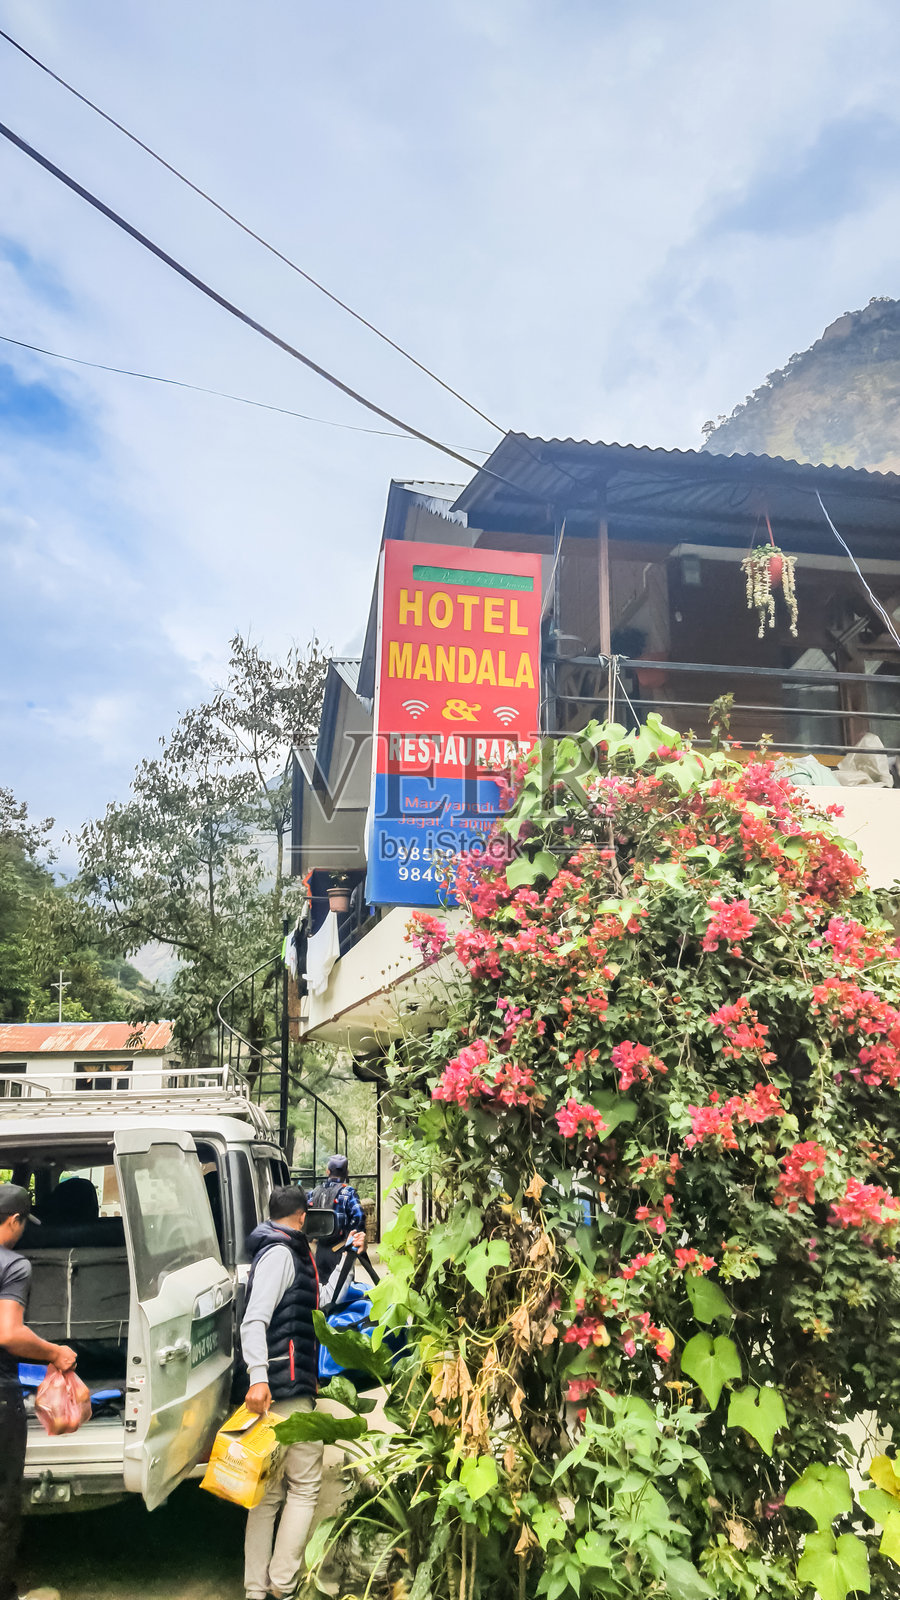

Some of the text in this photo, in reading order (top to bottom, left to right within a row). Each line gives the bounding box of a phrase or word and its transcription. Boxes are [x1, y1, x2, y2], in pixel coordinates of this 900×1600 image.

[398, 588, 529, 636] HOTEL
[387, 640, 536, 689] MANDALA
[441, 698, 482, 722] &
